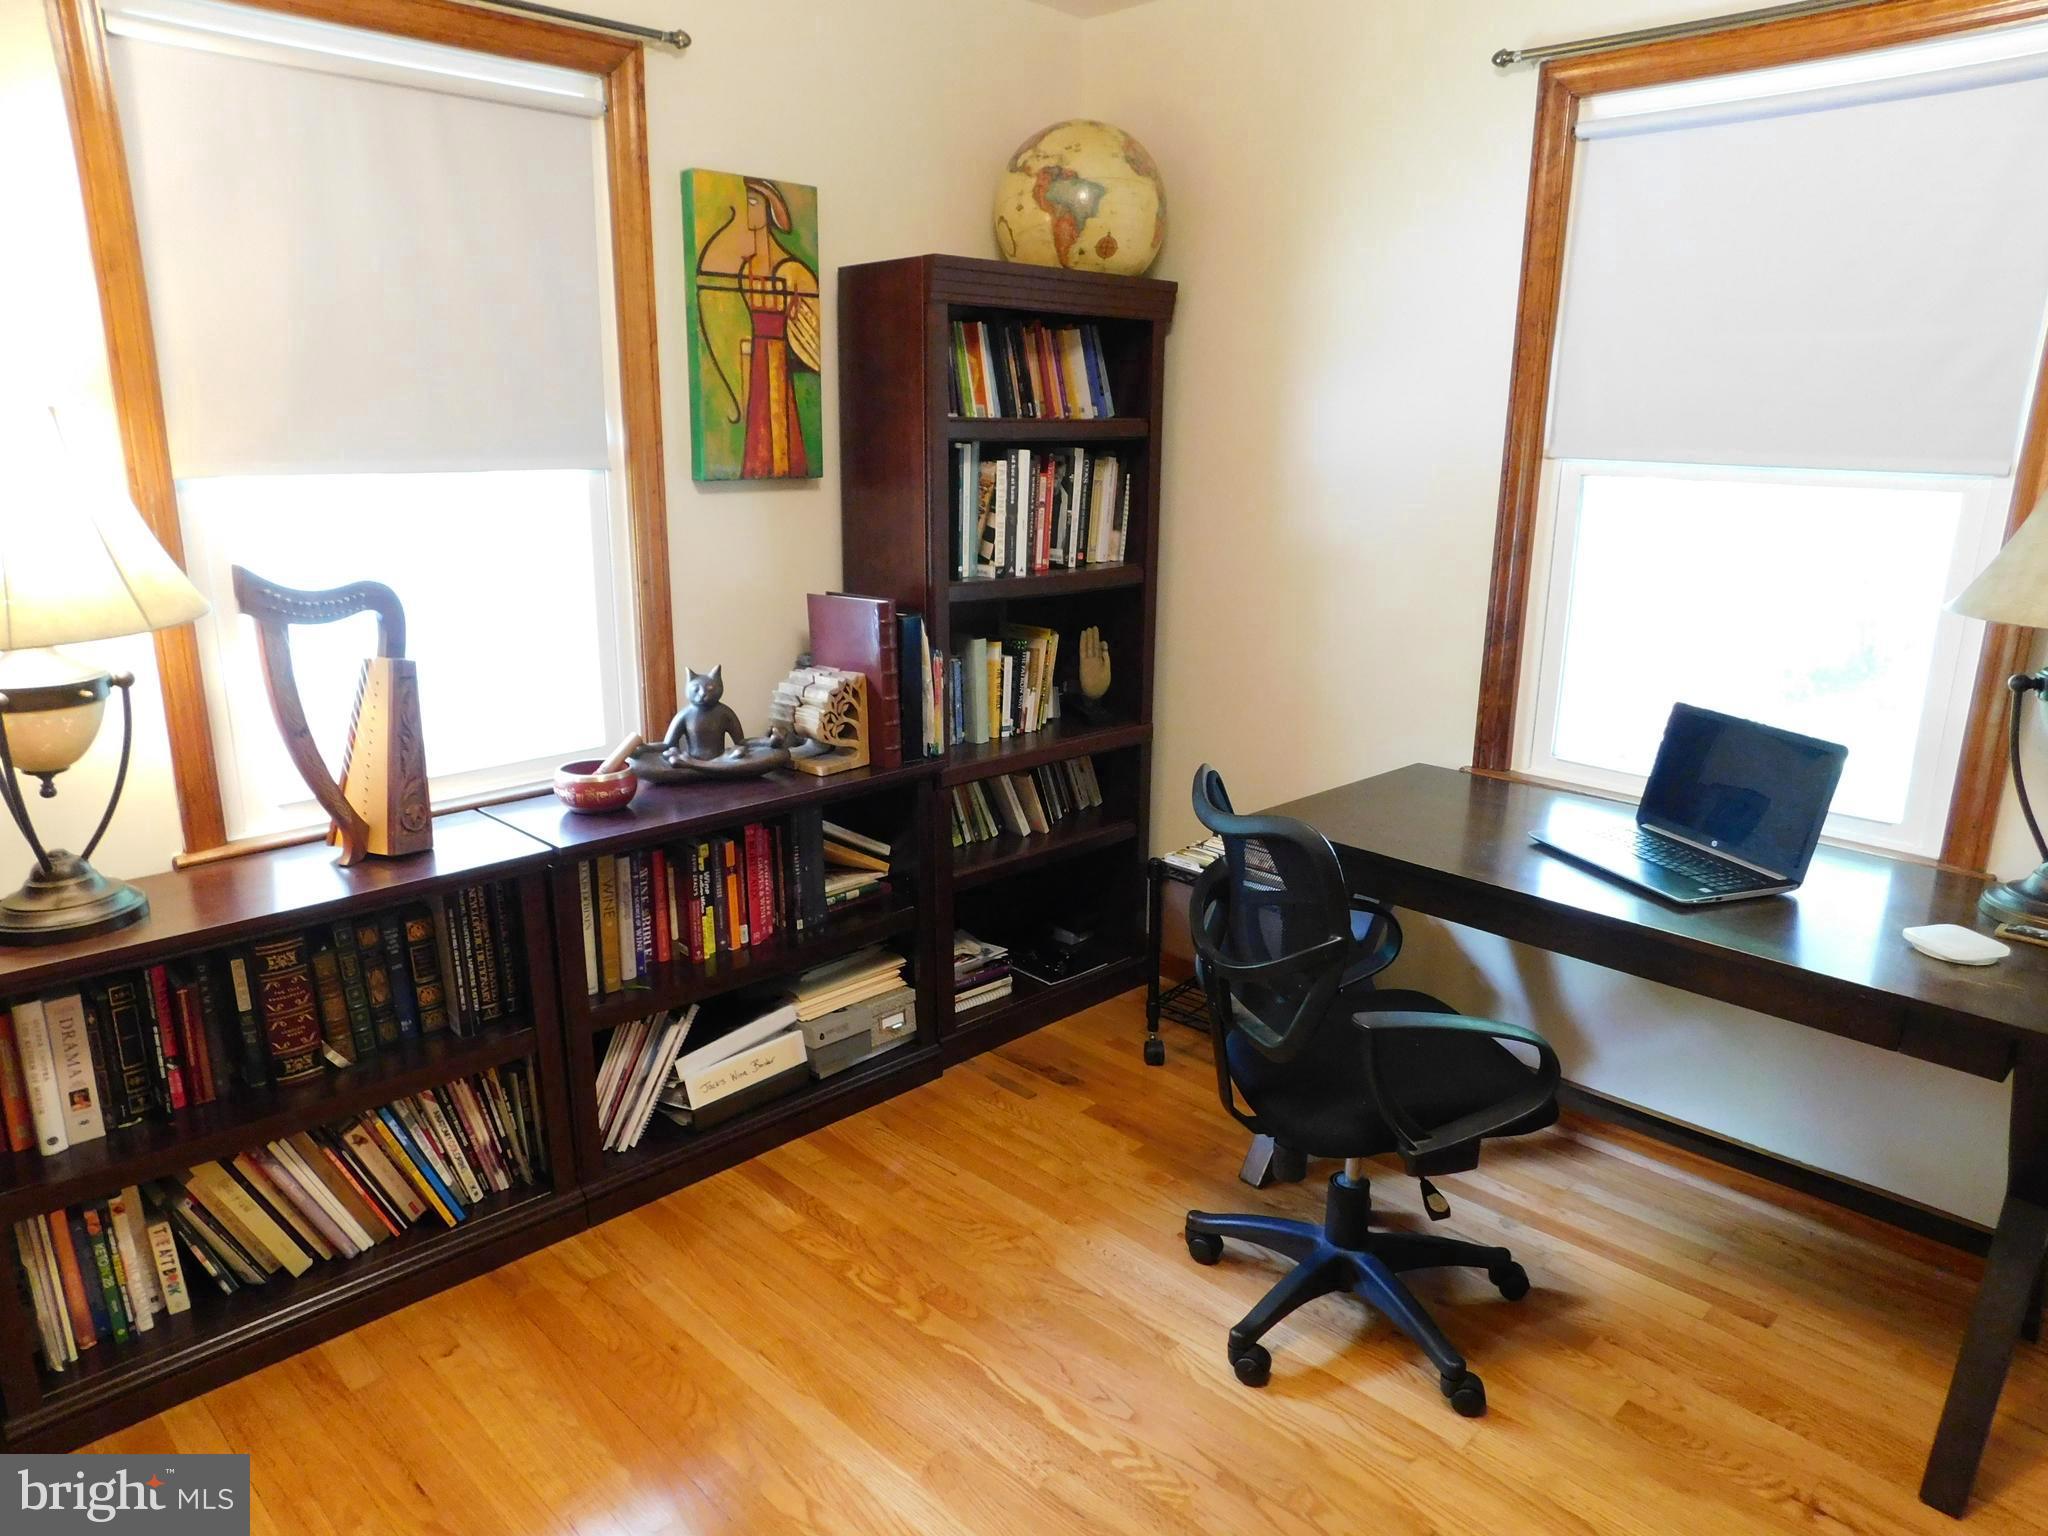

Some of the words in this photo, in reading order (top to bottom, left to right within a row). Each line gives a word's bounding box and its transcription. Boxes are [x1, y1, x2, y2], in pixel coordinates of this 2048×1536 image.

[703, 871, 711, 895] Wine
[601, 880, 615, 920] WINE
[635, 928, 644, 952] WINE
[58, 1017, 83, 1080] DRAMA
